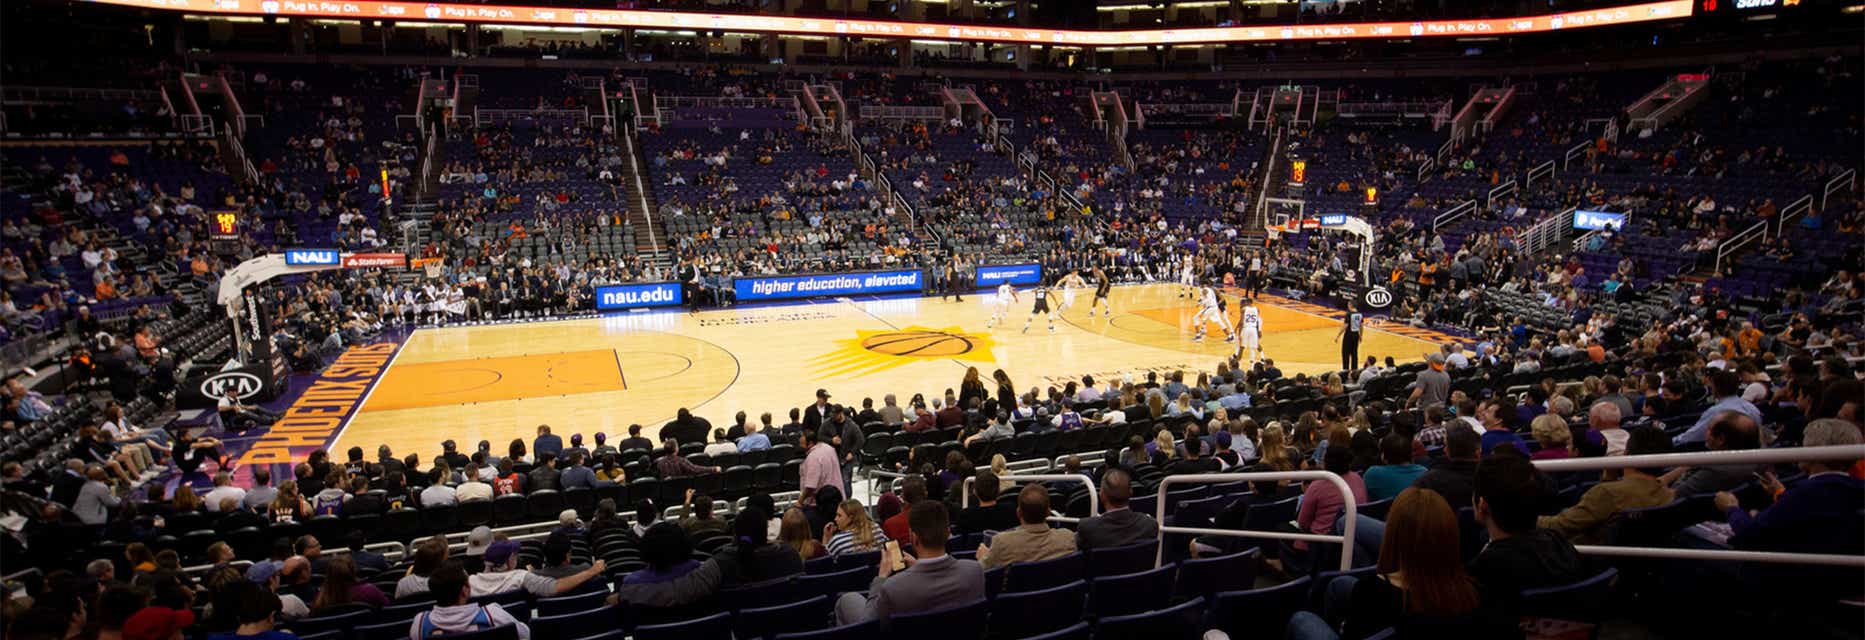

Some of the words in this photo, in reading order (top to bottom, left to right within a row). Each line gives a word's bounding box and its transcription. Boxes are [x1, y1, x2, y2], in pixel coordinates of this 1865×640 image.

[284, 1, 306, 12] Plug
[320, 3, 341, 13] Play
[445, 8, 465, 17] Plug
[479, 9, 497, 18] Play
[1428, 23, 1446, 32] Plug
[1458, 22, 1476, 32] Play
[292, 251, 332, 263] NAU
[752, 279, 795, 295] higher
[797, 276, 862, 291] education,
[865, 273, 916, 287] elevated
[604, 286, 674, 305] nau.edu
[1369, 293, 1388, 304] KIA
[1245, 314, 1257, 323] 25
[234, 377, 372, 464] PHOENIX
[321, 342, 398, 378] SUNS
